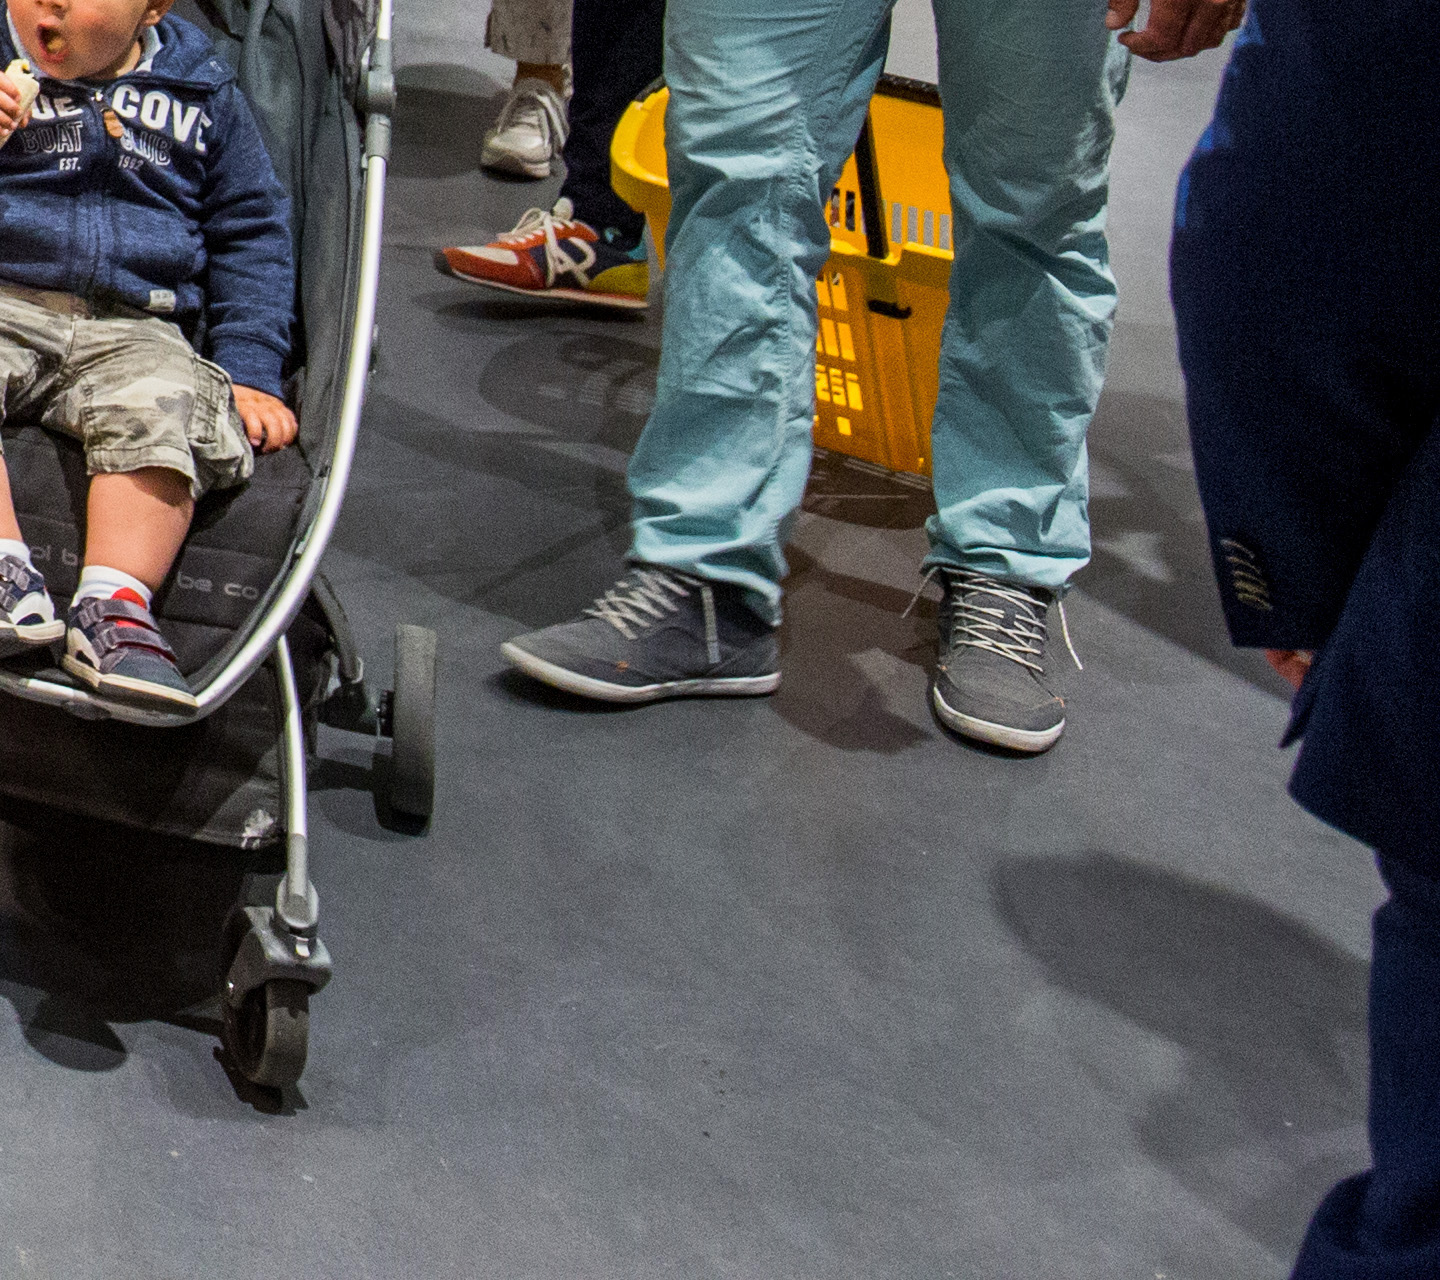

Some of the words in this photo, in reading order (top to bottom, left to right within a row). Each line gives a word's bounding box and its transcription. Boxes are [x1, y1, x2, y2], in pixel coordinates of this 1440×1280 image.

[112, 85, 212, 152] COVE
[21, 121, 83, 154] BOAT
[59, 157, 81, 171] EST.
